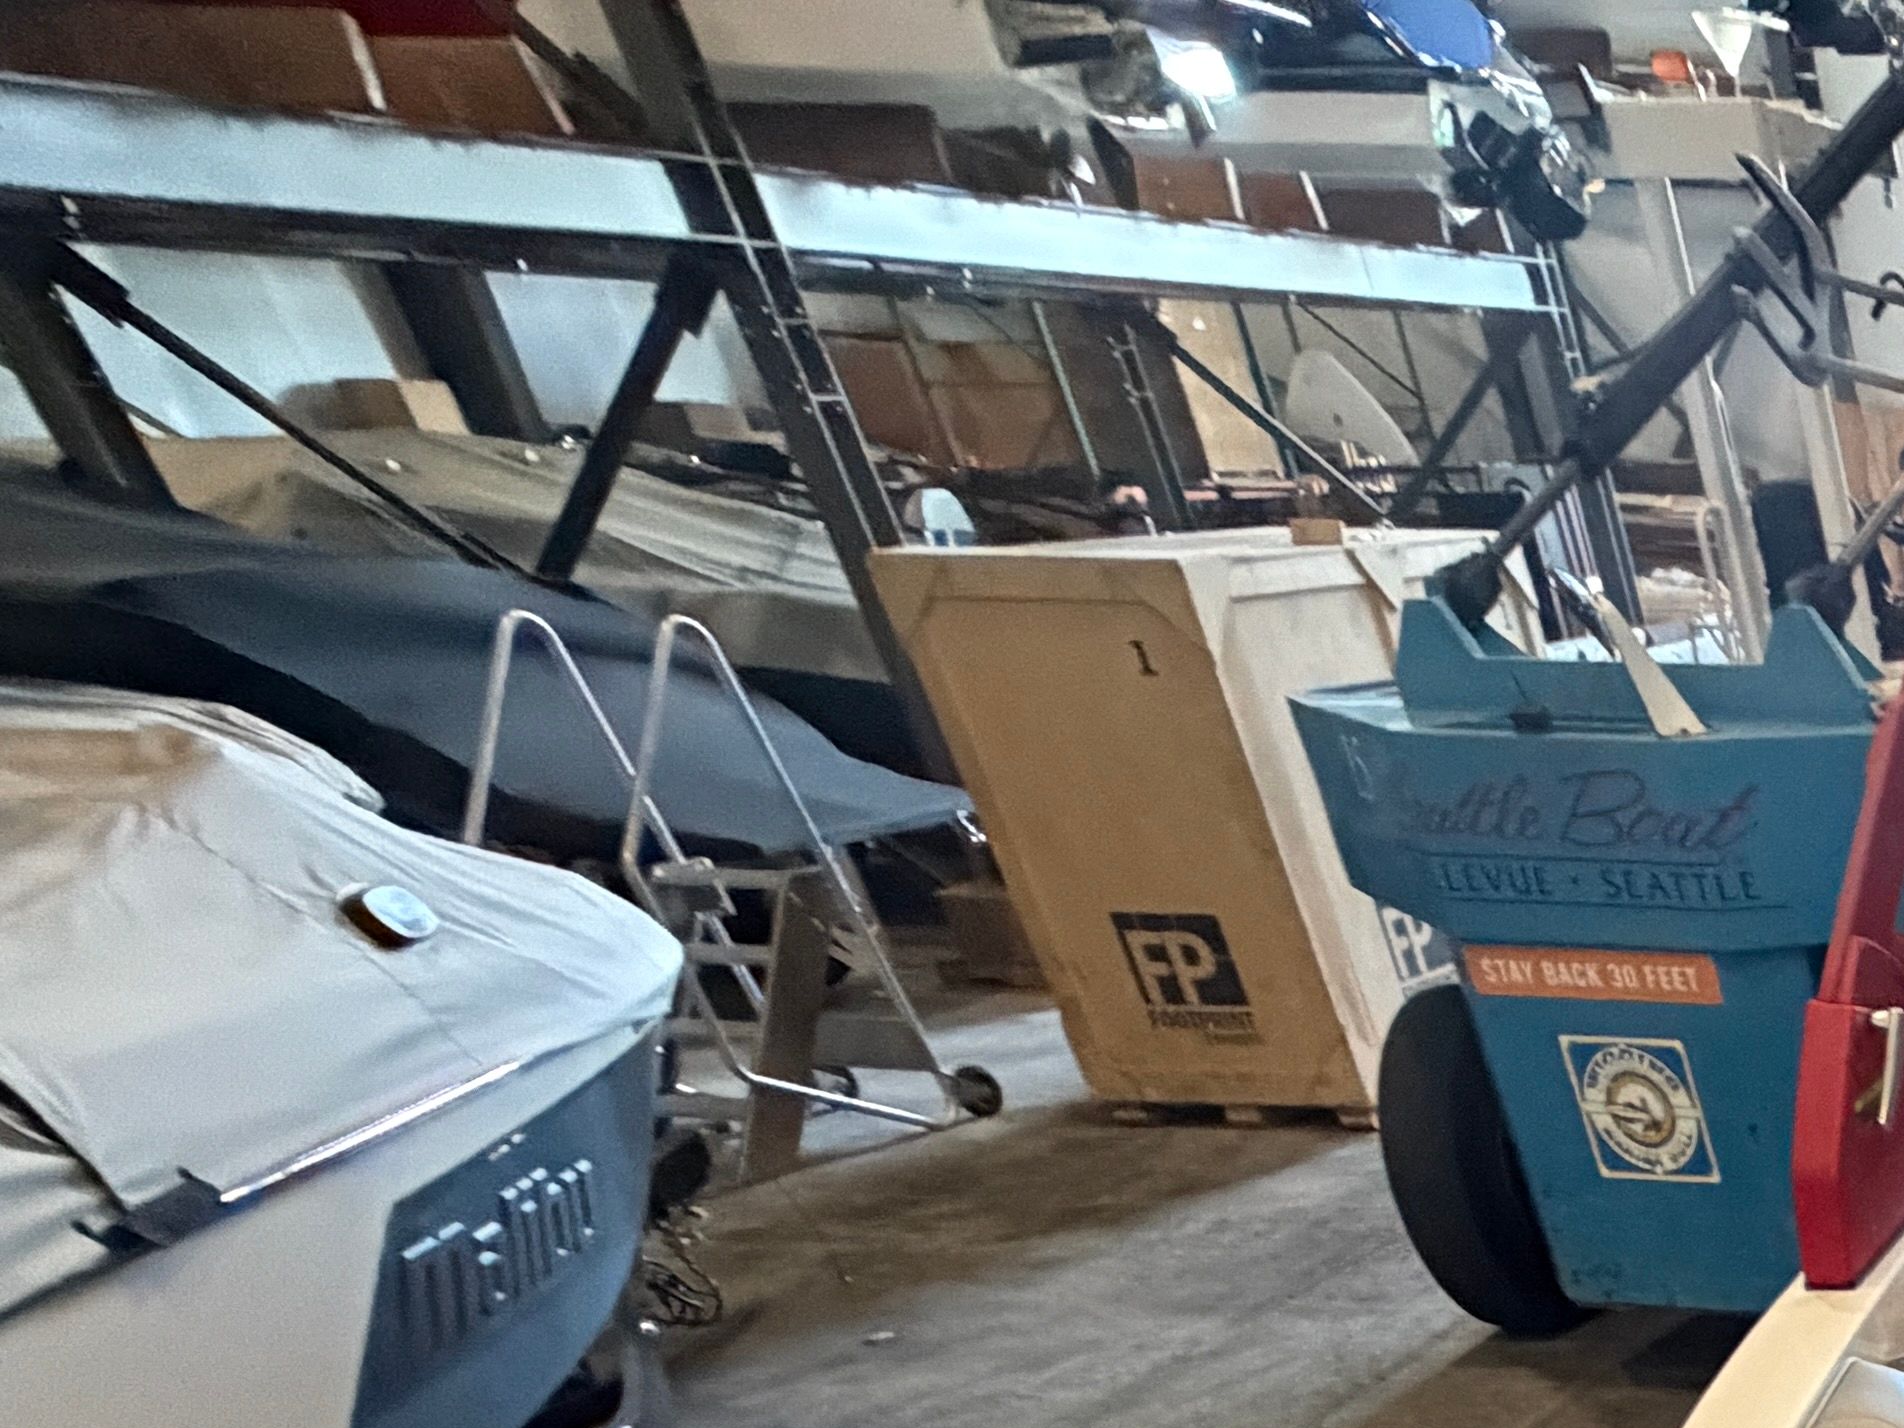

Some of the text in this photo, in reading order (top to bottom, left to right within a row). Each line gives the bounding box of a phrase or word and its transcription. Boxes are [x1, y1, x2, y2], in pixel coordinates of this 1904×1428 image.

[1604, 868, 1762, 902] SEATTLE
[1481, 956, 1700, 993] STAY BACK 30 FEET
